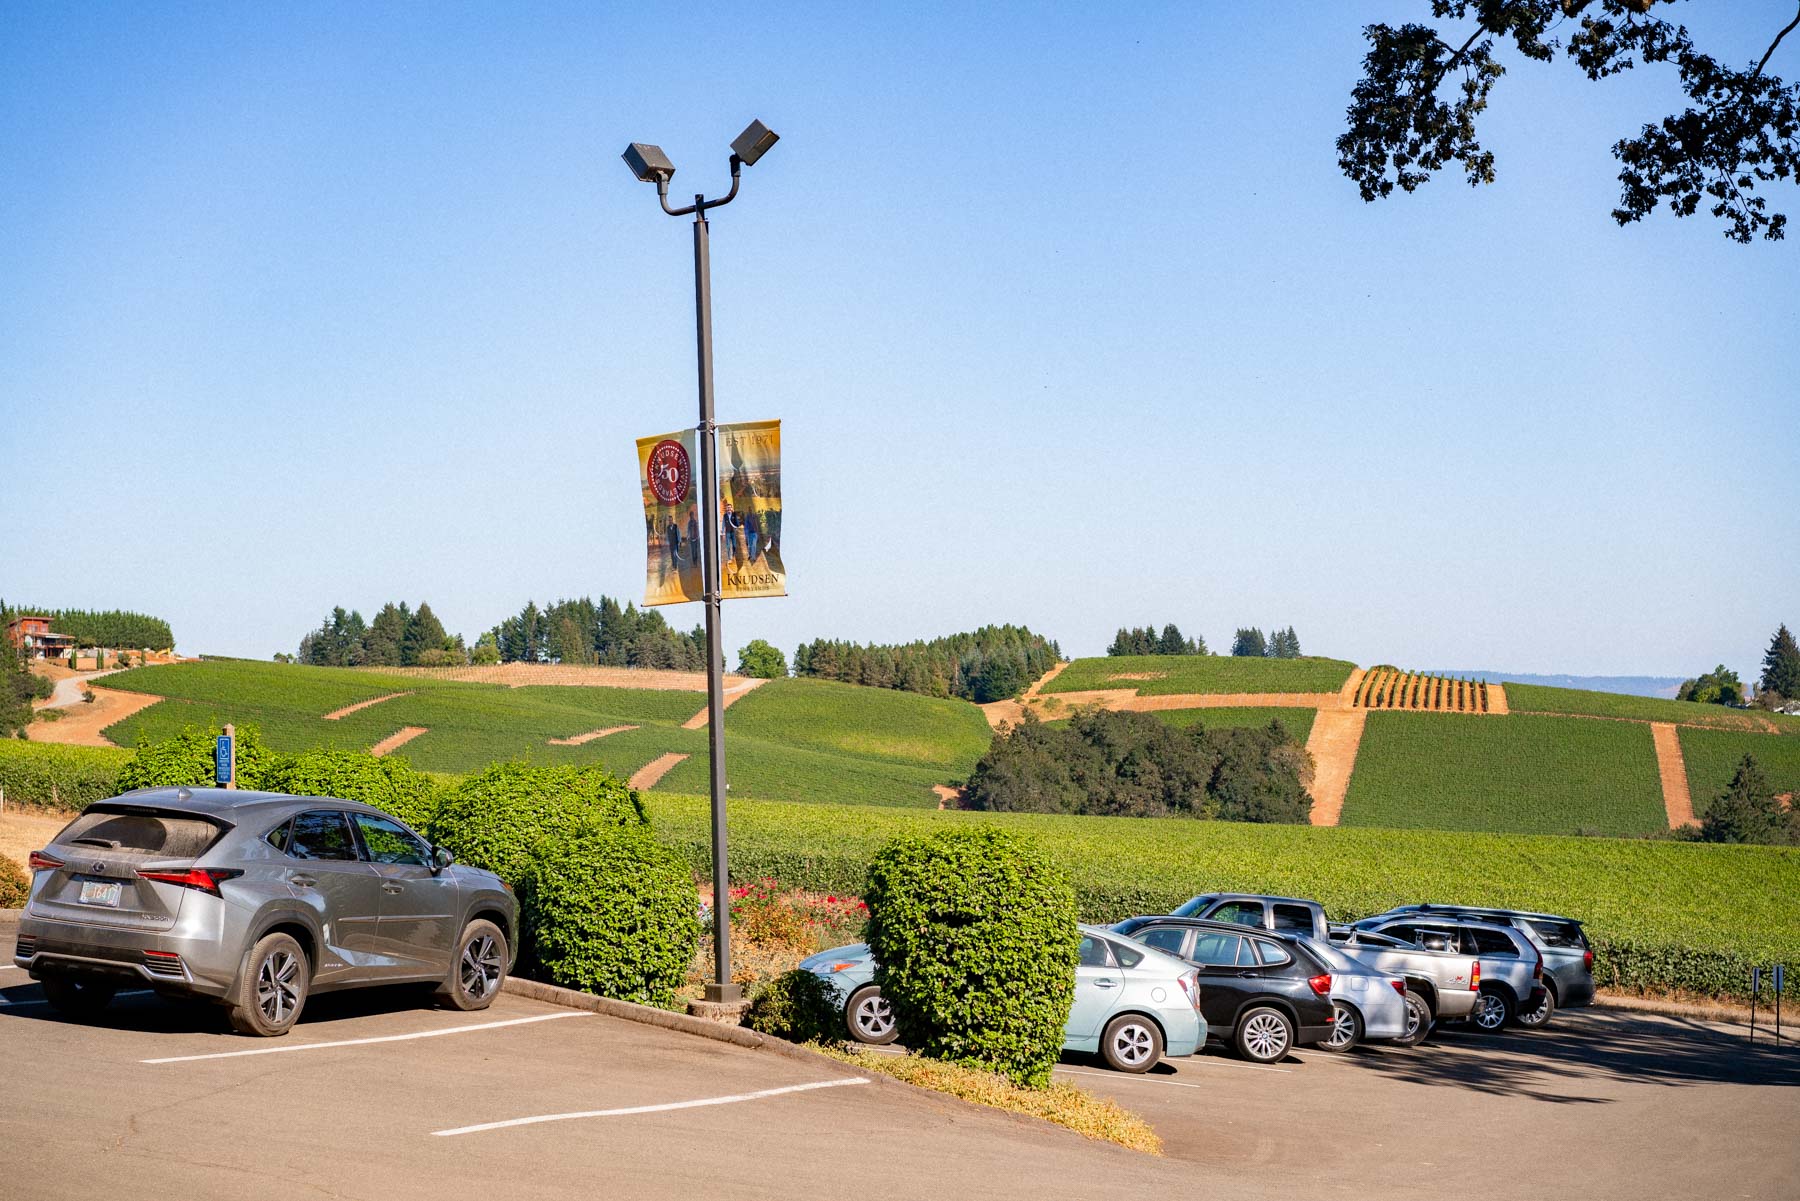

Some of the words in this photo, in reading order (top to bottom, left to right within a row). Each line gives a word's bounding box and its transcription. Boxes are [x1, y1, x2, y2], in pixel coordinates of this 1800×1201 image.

[752, 434, 773, 445] 1971
[658, 463, 679, 483] 50
[727, 573, 780, 586] KNUDSEN
